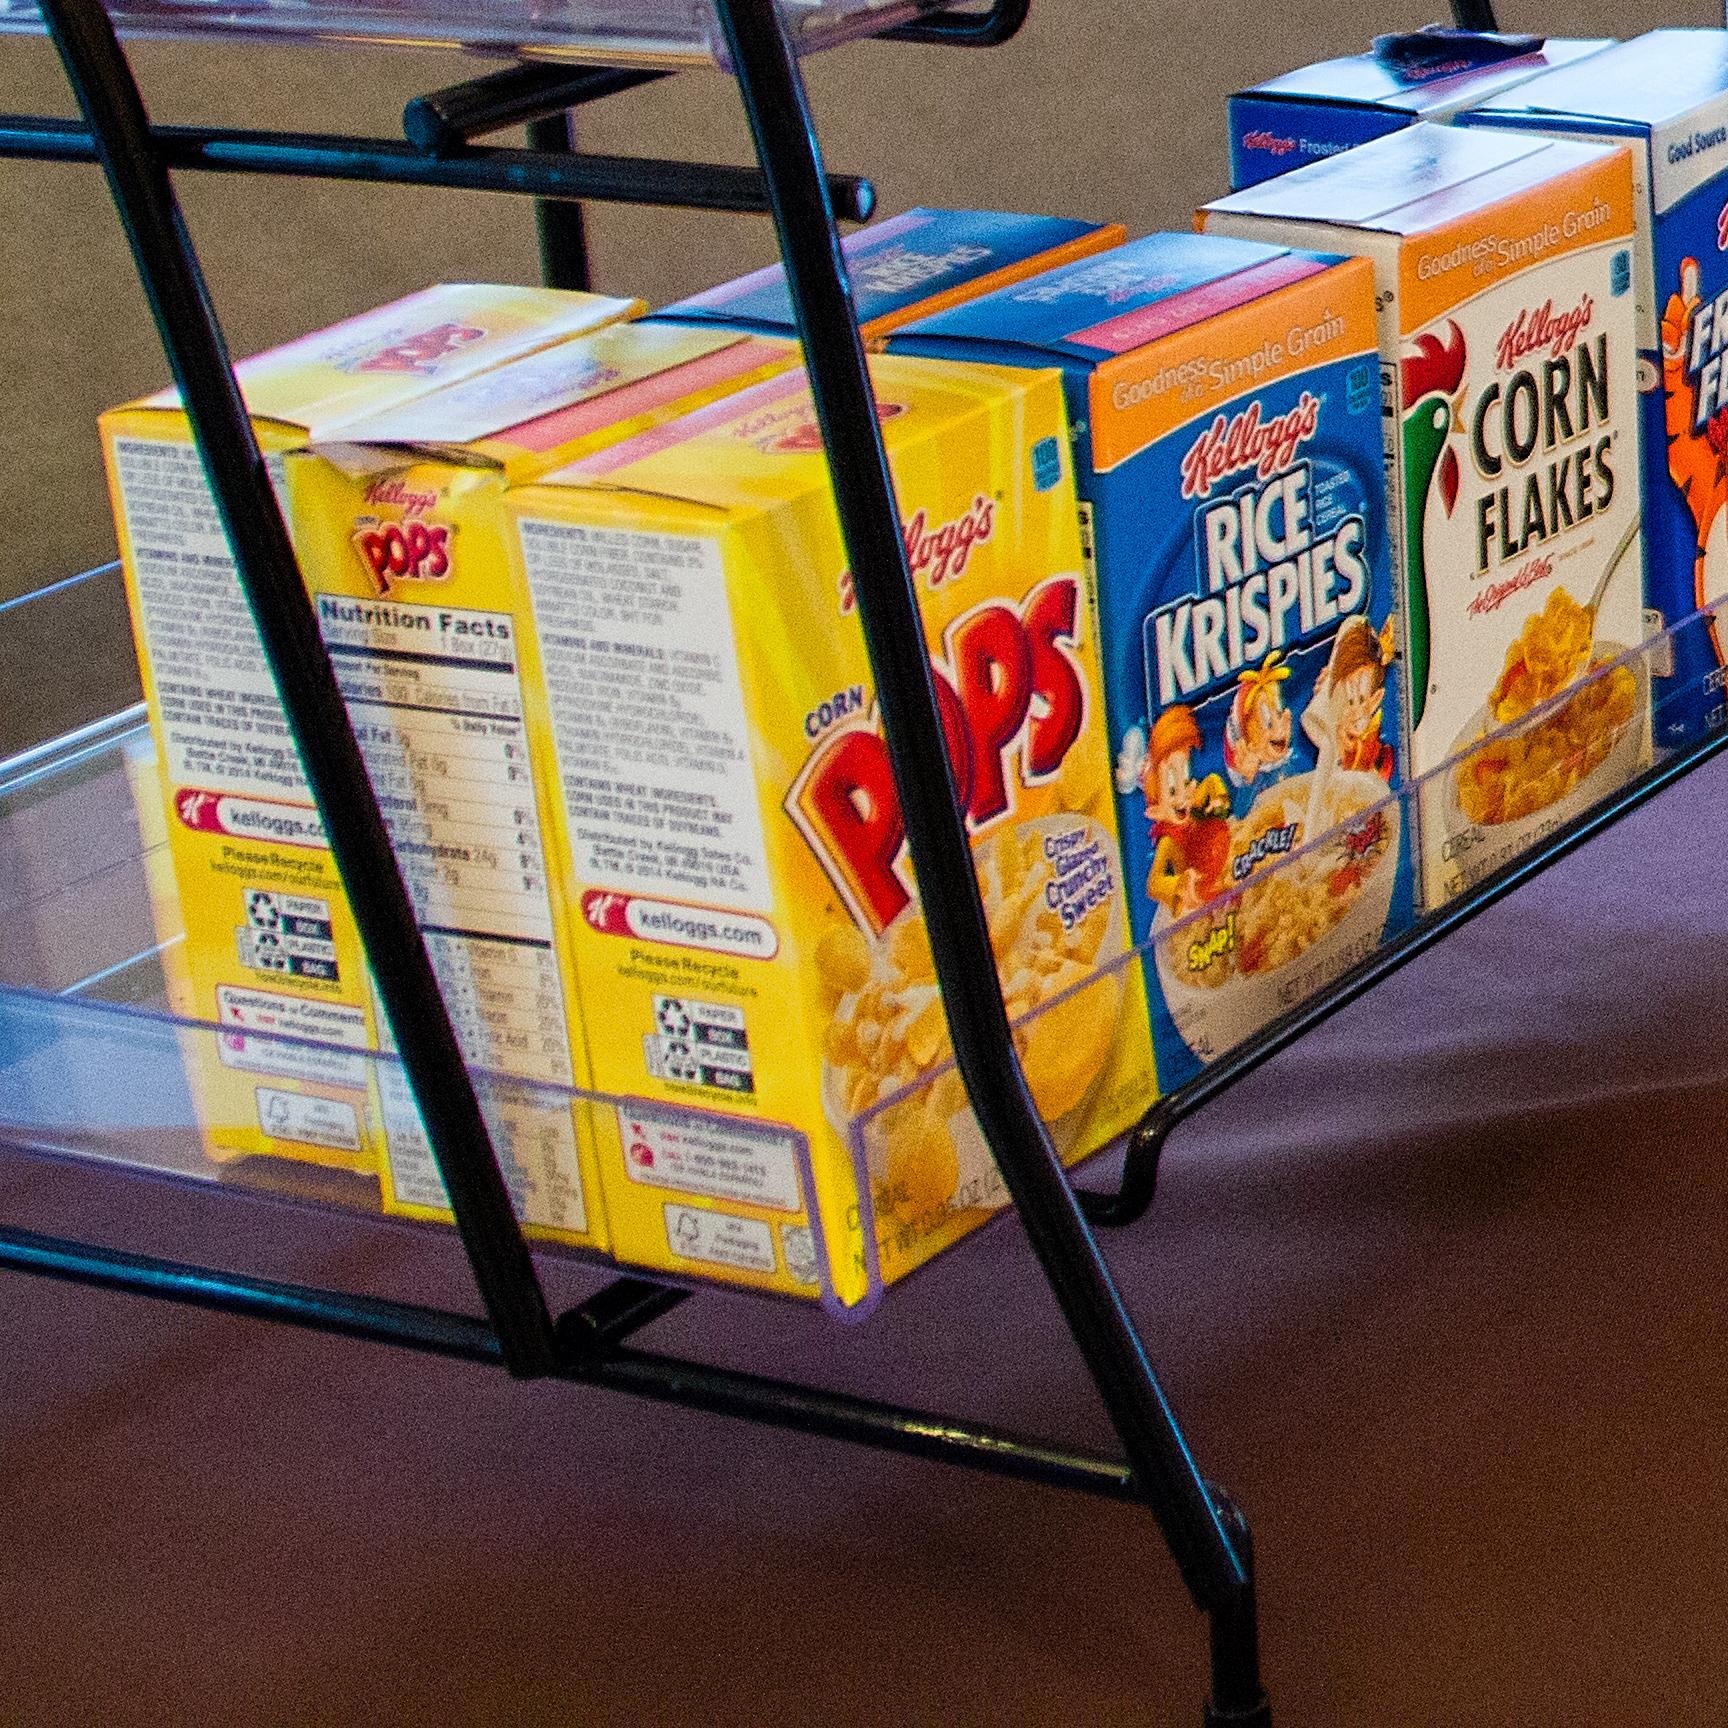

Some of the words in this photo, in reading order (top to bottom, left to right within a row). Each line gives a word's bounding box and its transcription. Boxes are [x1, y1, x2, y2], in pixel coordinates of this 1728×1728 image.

[1667, 134, 1693, 166] Good
[1695, 124, 1726, 155] Source
[1418, 233, 1500, 281] Goodness
[1498, 223, 1560, 268] Simple
[1562, 195, 1612, 239] Grain
[1112, 356, 1208, 412] Goodness
[1209, 341, 1284, 391] Simple
[1286, 308, 1346, 357] Grain
[1497, 293, 1594, 372] Kellogg's
[1470, 331, 1611, 479] CORN
[1182, 390, 1321, 500] Kellogg's
[364, 479, 438, 516] Kellogg's
[1206, 467, 1312, 594] RICE
[1474, 434, 1617, 578] FLAKES
[363, 522, 450, 593] POPS
[319, 600, 432, 632] Nutrition
[438, 613, 510, 640] Facts
[1154, 519, 1368, 706] KRISPIES
[803, 684, 864, 740] CORN
[229, 807, 325, 838] kelloggs.co
[1045, 855, 1108, 910] Crunchy
[1060, 872, 1115, 930] Sweet
[638, 909, 763, 946] kelloggs.com
